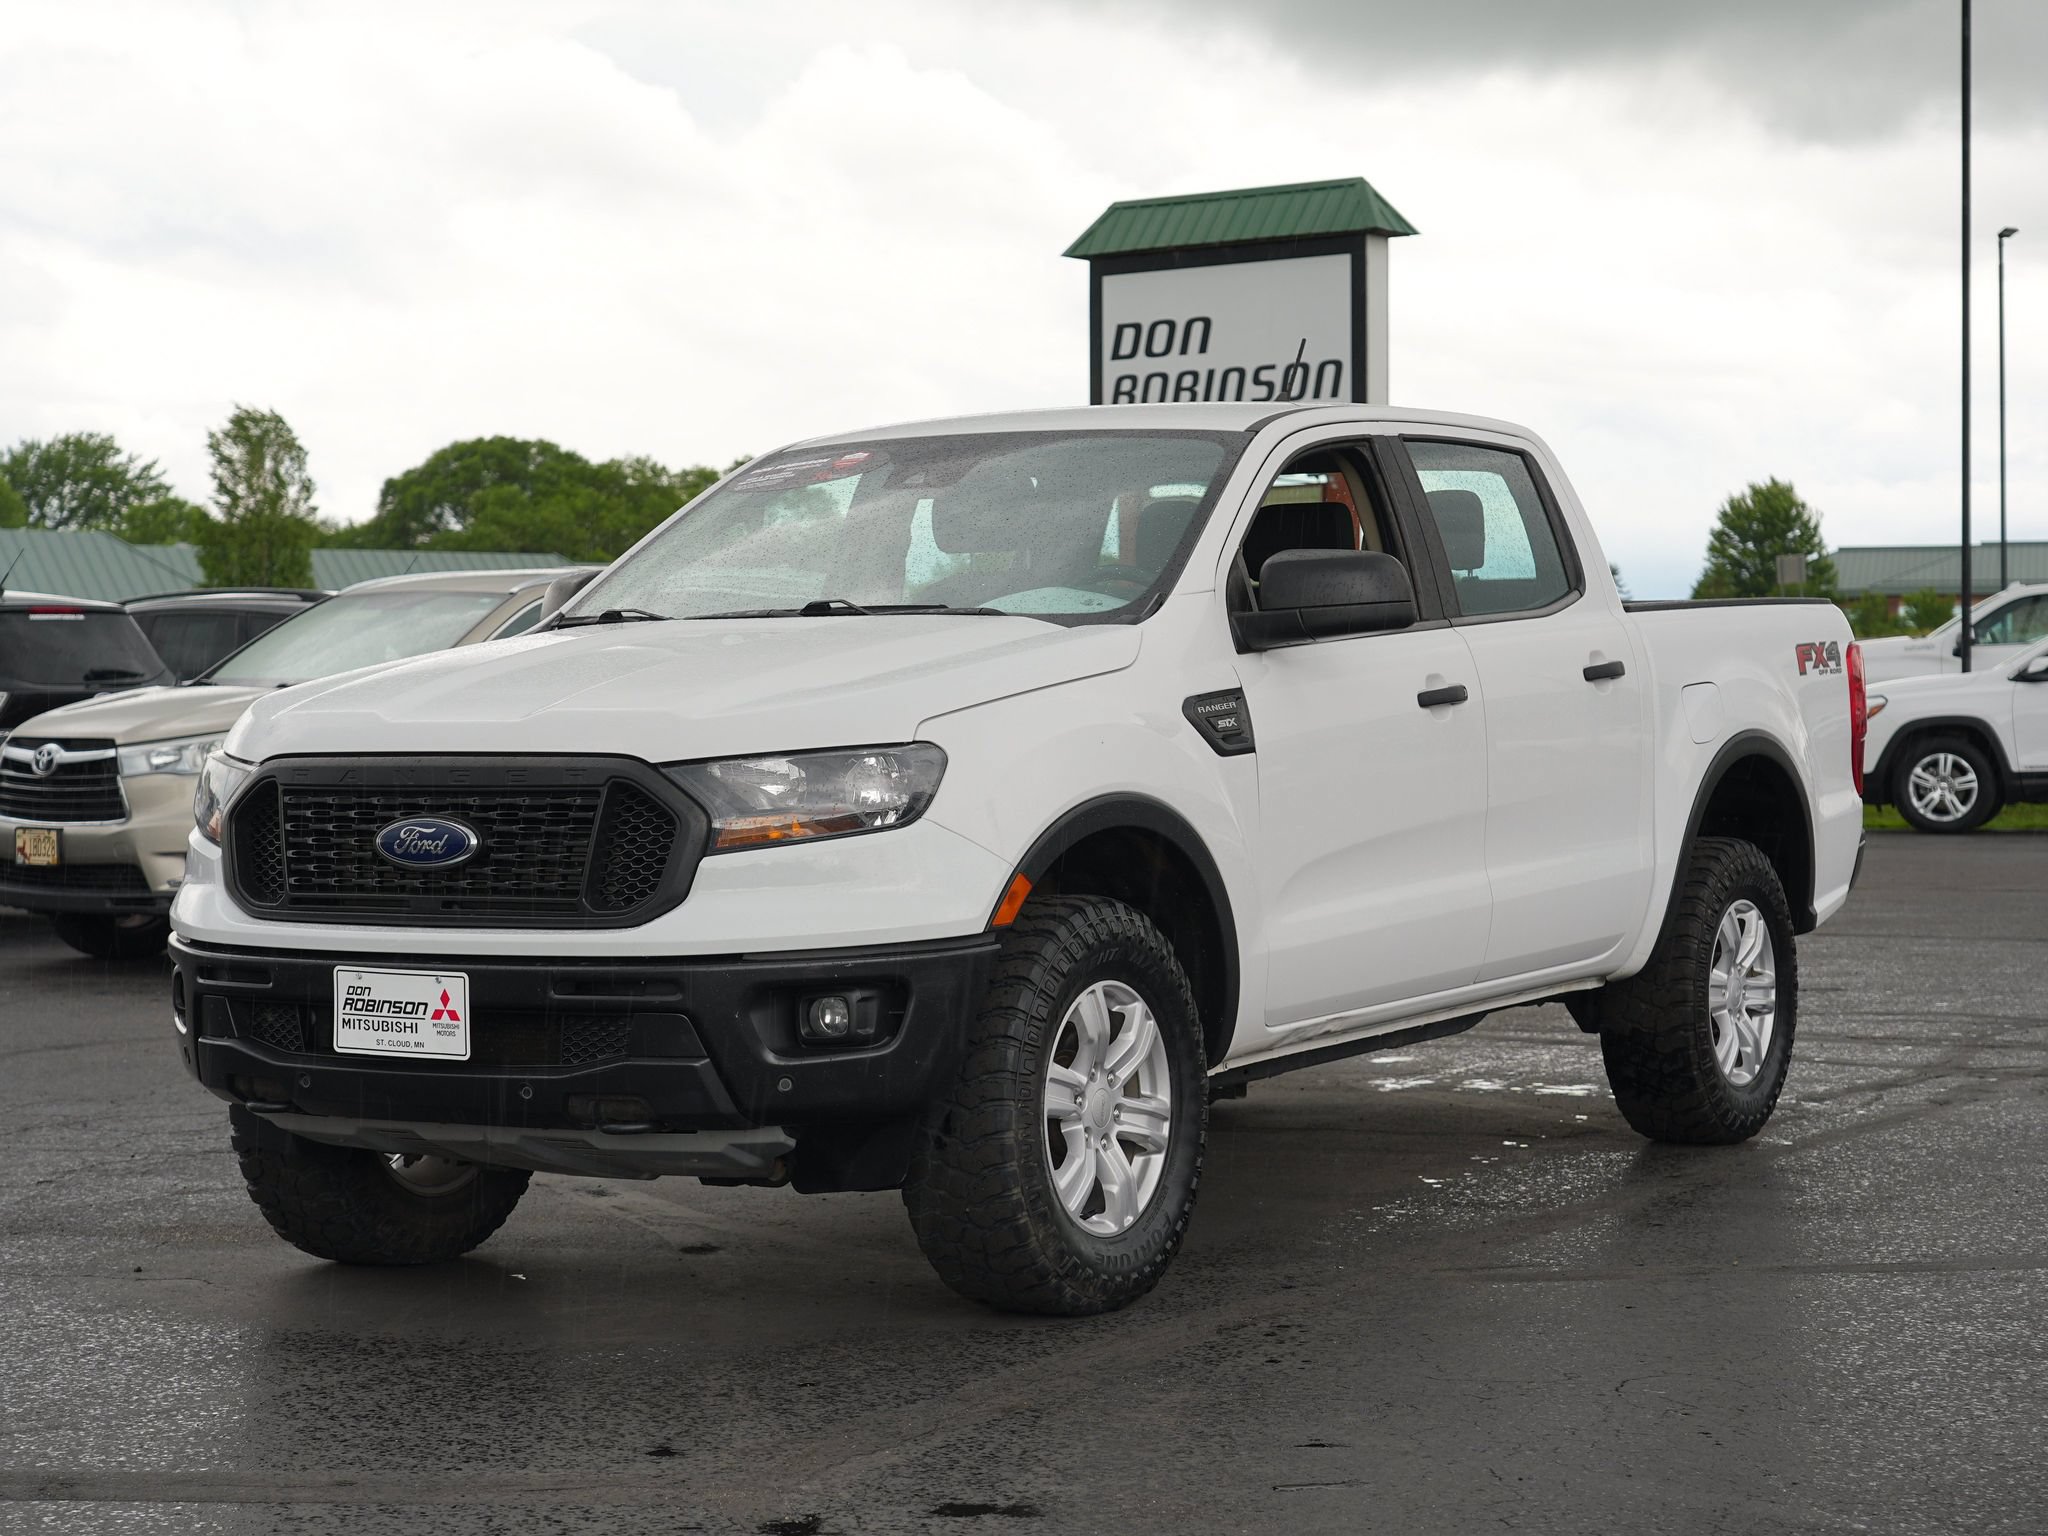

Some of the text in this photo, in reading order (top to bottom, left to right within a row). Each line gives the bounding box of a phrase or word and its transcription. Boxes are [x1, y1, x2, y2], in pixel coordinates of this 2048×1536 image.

[1110, 316, 1212, 361] DON
[1112, 358, 1343, 404] ROBINSON
[1795, 640, 1842, 676] FX4
[1197, 701, 1237, 714] RANGER
[1217, 717, 1238, 729] STX
[393, 826, 449, 855] Ford
[347, 986, 371, 996] DON
[342, 997, 428, 1016] ROBINSON
[342, 1018, 418, 1034] MITSUBISHI
[432, 1022, 460, 1030] MITSUBISHI
[376, 1038, 387, 1046] ST.
[413, 1041, 425, 1049] MN
